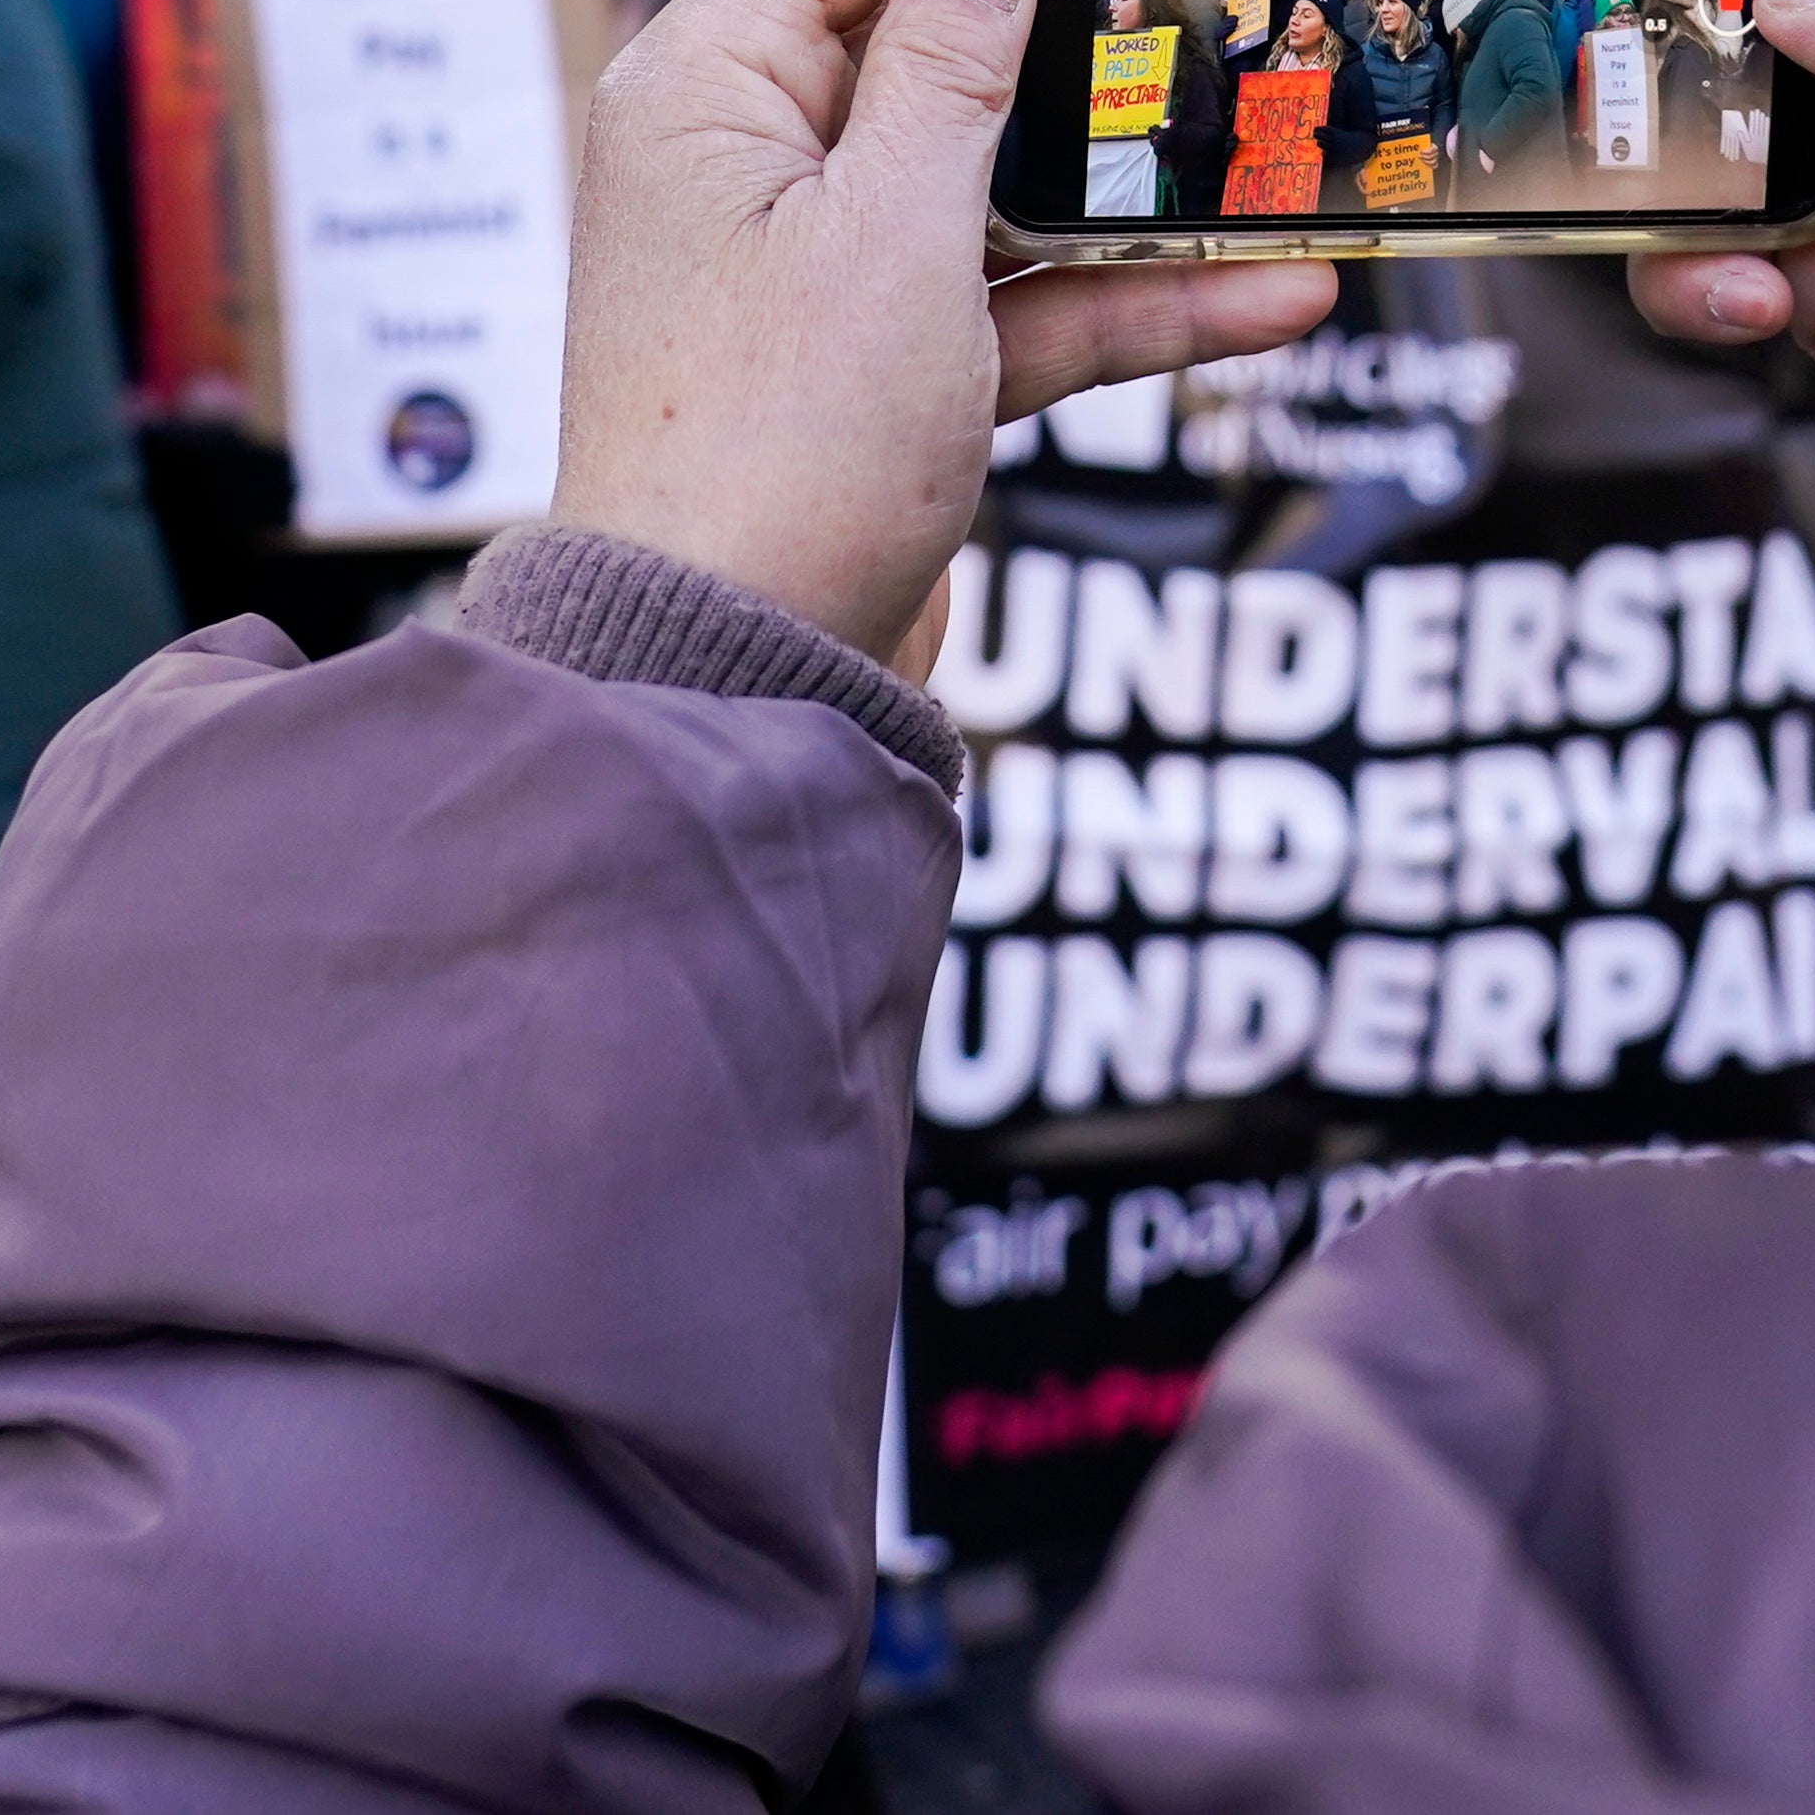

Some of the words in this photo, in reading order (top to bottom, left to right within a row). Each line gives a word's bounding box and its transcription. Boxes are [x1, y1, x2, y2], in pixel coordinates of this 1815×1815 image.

[1645, 18, 1667, 32] 0.5
[1105, 37, 1160, 55] WORKED
[1104, 57, 1149, 81] PAID
[1610, 60, 1627, 72] Pay
[1601, 96, 1639, 108] Feminist
[1394, 143, 1420, 155] time
[1381, 159, 1392, 171] to
[1395, 158, 1416, 170] pay
[1377, 168, 1420, 184] nursing
[1370, 184, 1397, 198] staff
[1399, 179, 1428, 194] fairly
[917, 1181, 1088, 1309] air
[1107, 1173, 1306, 1315] pay
